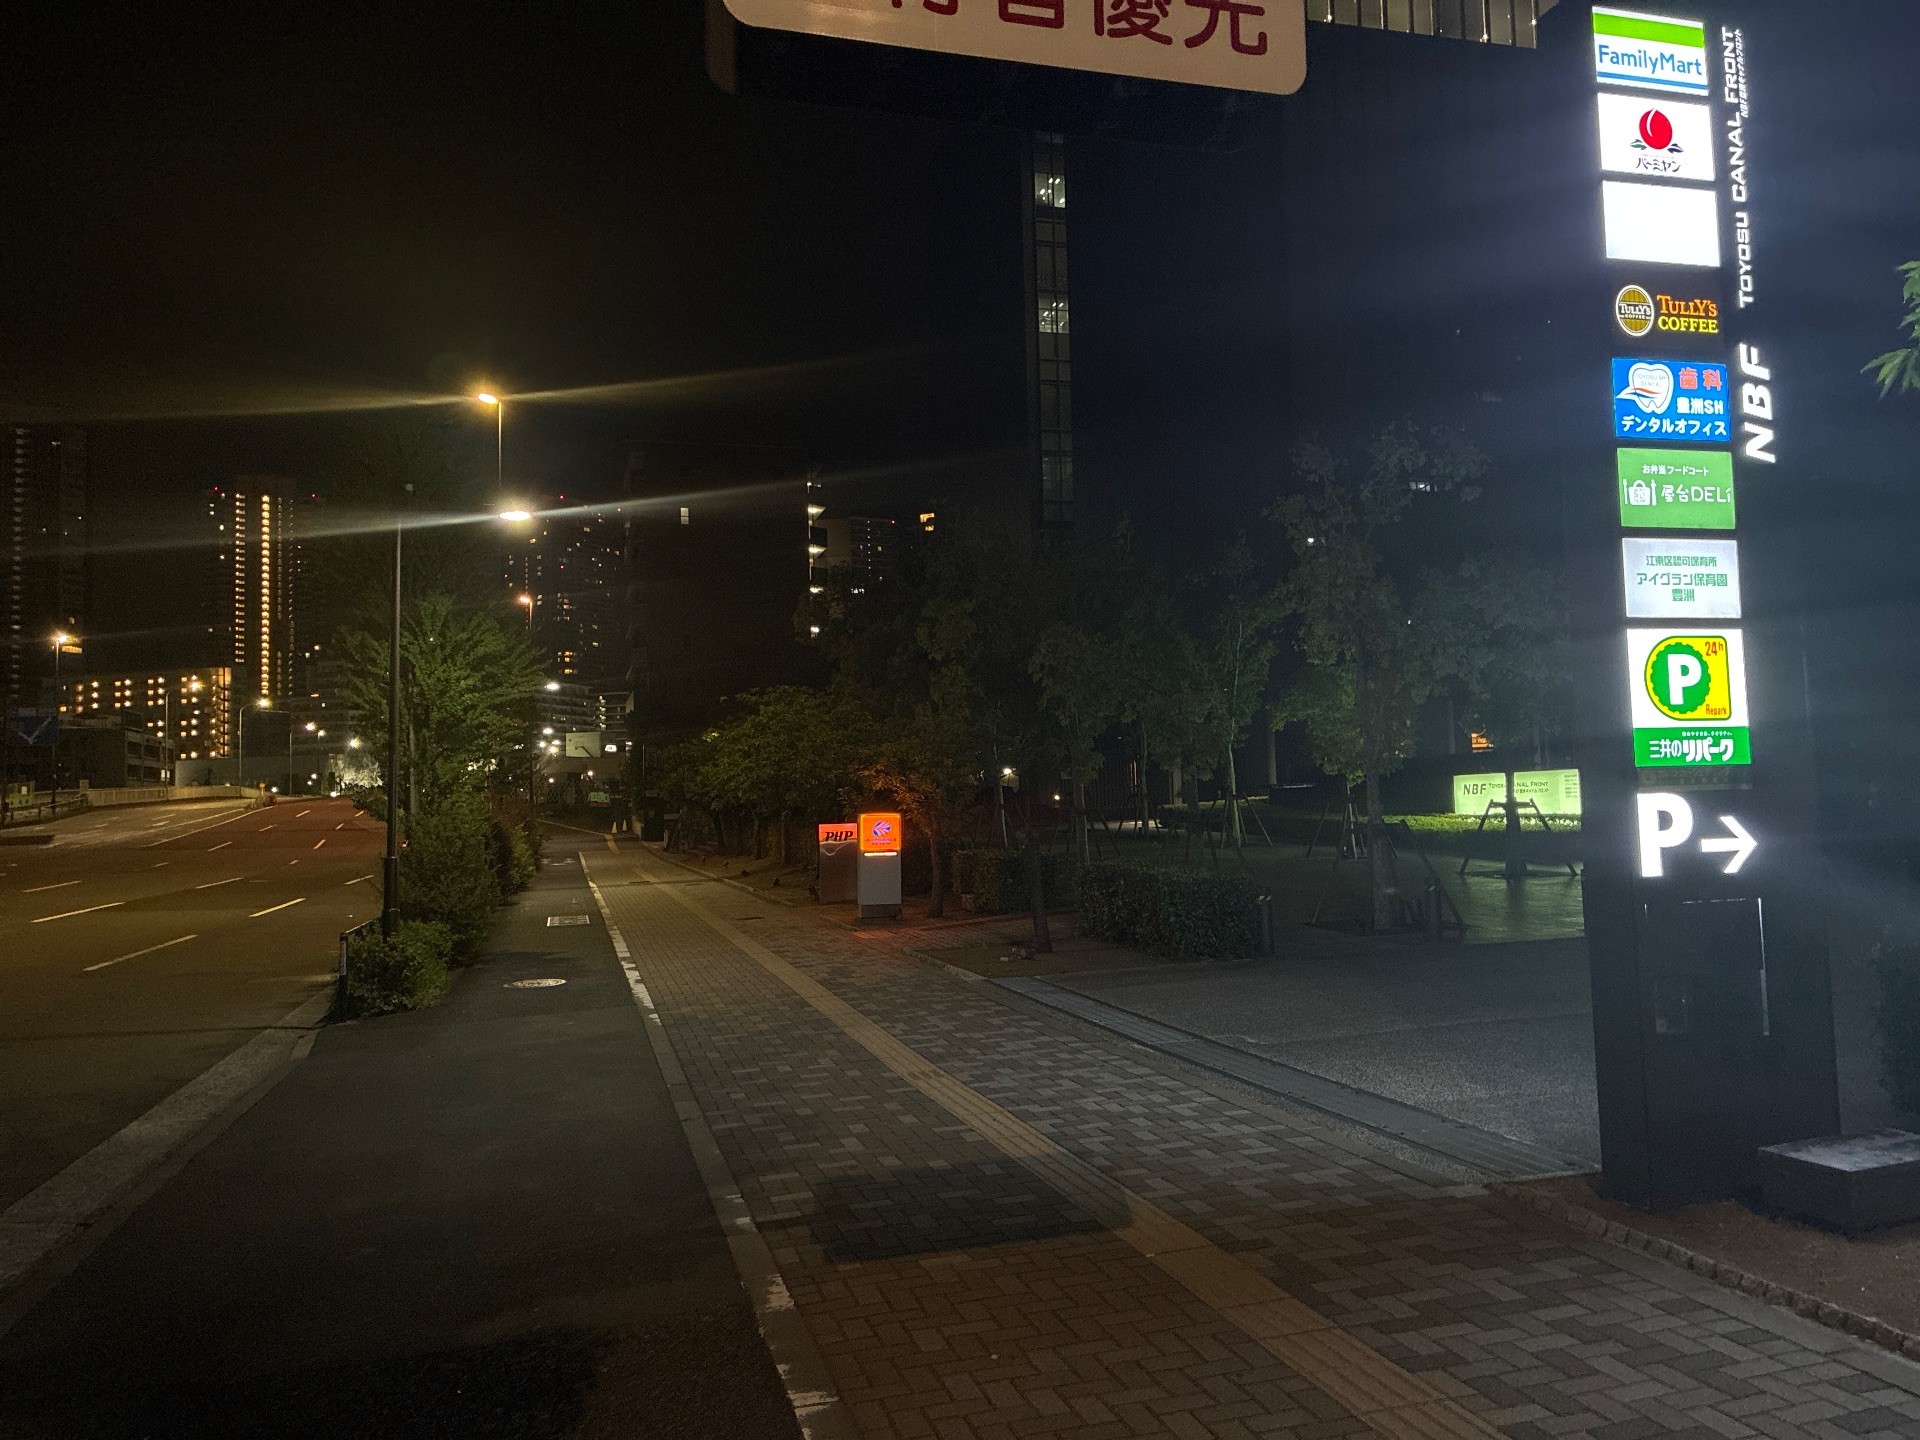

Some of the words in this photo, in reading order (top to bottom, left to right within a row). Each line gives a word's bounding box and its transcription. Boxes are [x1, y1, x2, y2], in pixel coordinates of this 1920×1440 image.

[1598, 45, 1702, 75] FamilyMart
[1722, 26, 1740, 104] FRONT
[1635, 158, 1682, 173] バーミヤン
[1727, 112, 1747, 203] CANAL
[1736, 212, 1754, 308] TOYOSU
[1657, 295, 1718, 317] TULLY'S
[1658, 316, 1718, 334] COFFEE
[1679, 367, 1722, 391] 歯科
[1740, 342, 1776, 464] NBF
[1621, 415, 1727, 437] デンタルオフィス
[1642, 464, 1709, 477] お弁当フードコート
[1646, 555, 1717, 567] 江東区認可保育所
[1636, 572, 1728, 587] アイグラン保育園
[1672, 588, 1695, 602] 豊洲
[1667, 653, 1702, 705] P
[1705, 704, 1727, 716] Repark
[1649, 737, 1734, 762] 三井のリパーク
[1463, 783, 1487, 796] NBF
[1636, 792, 1694, 878] P
